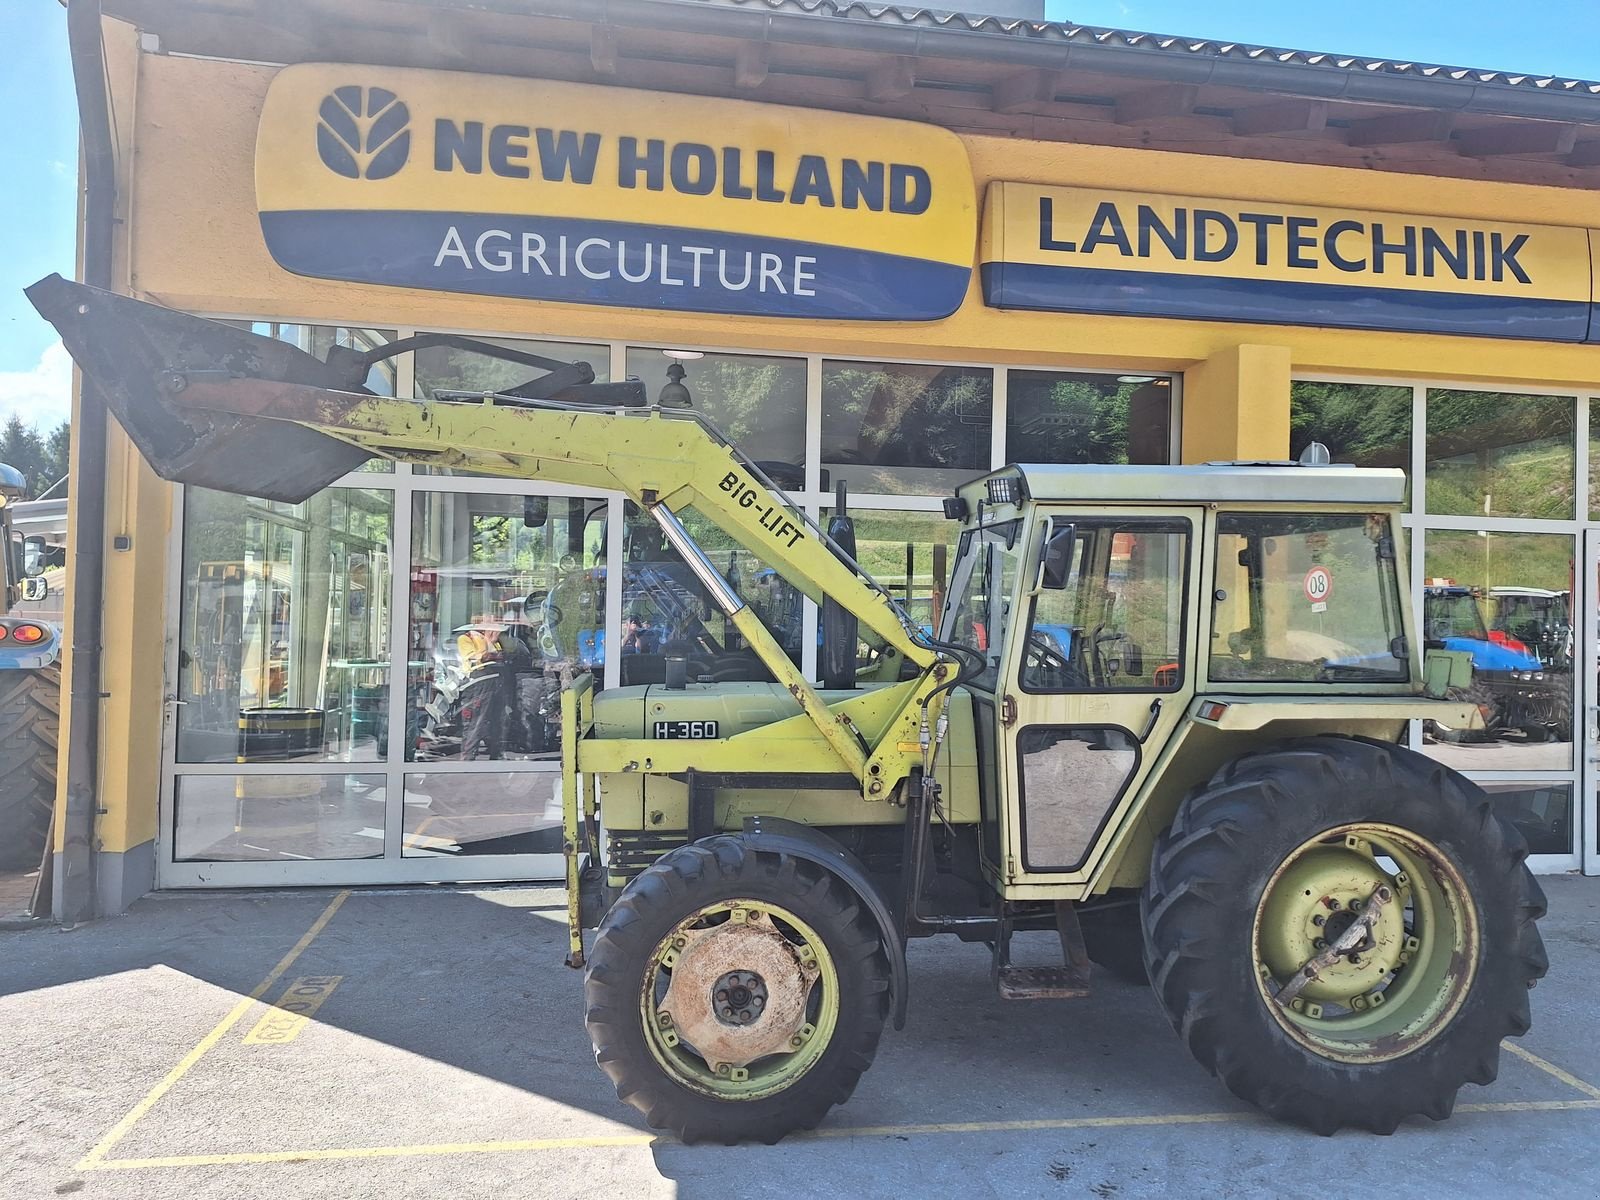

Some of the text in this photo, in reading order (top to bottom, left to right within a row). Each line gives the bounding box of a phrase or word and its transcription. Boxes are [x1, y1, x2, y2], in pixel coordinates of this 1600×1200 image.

[434, 118, 932, 216] NEW HOLLAND
[433, 226, 817, 297] AGRICULTURE
[1039, 197, 1532, 284] LANDTECHNIK
[718, 471, 805, 548] BIG-LIFT
[656, 722, 716, 738] H-360
